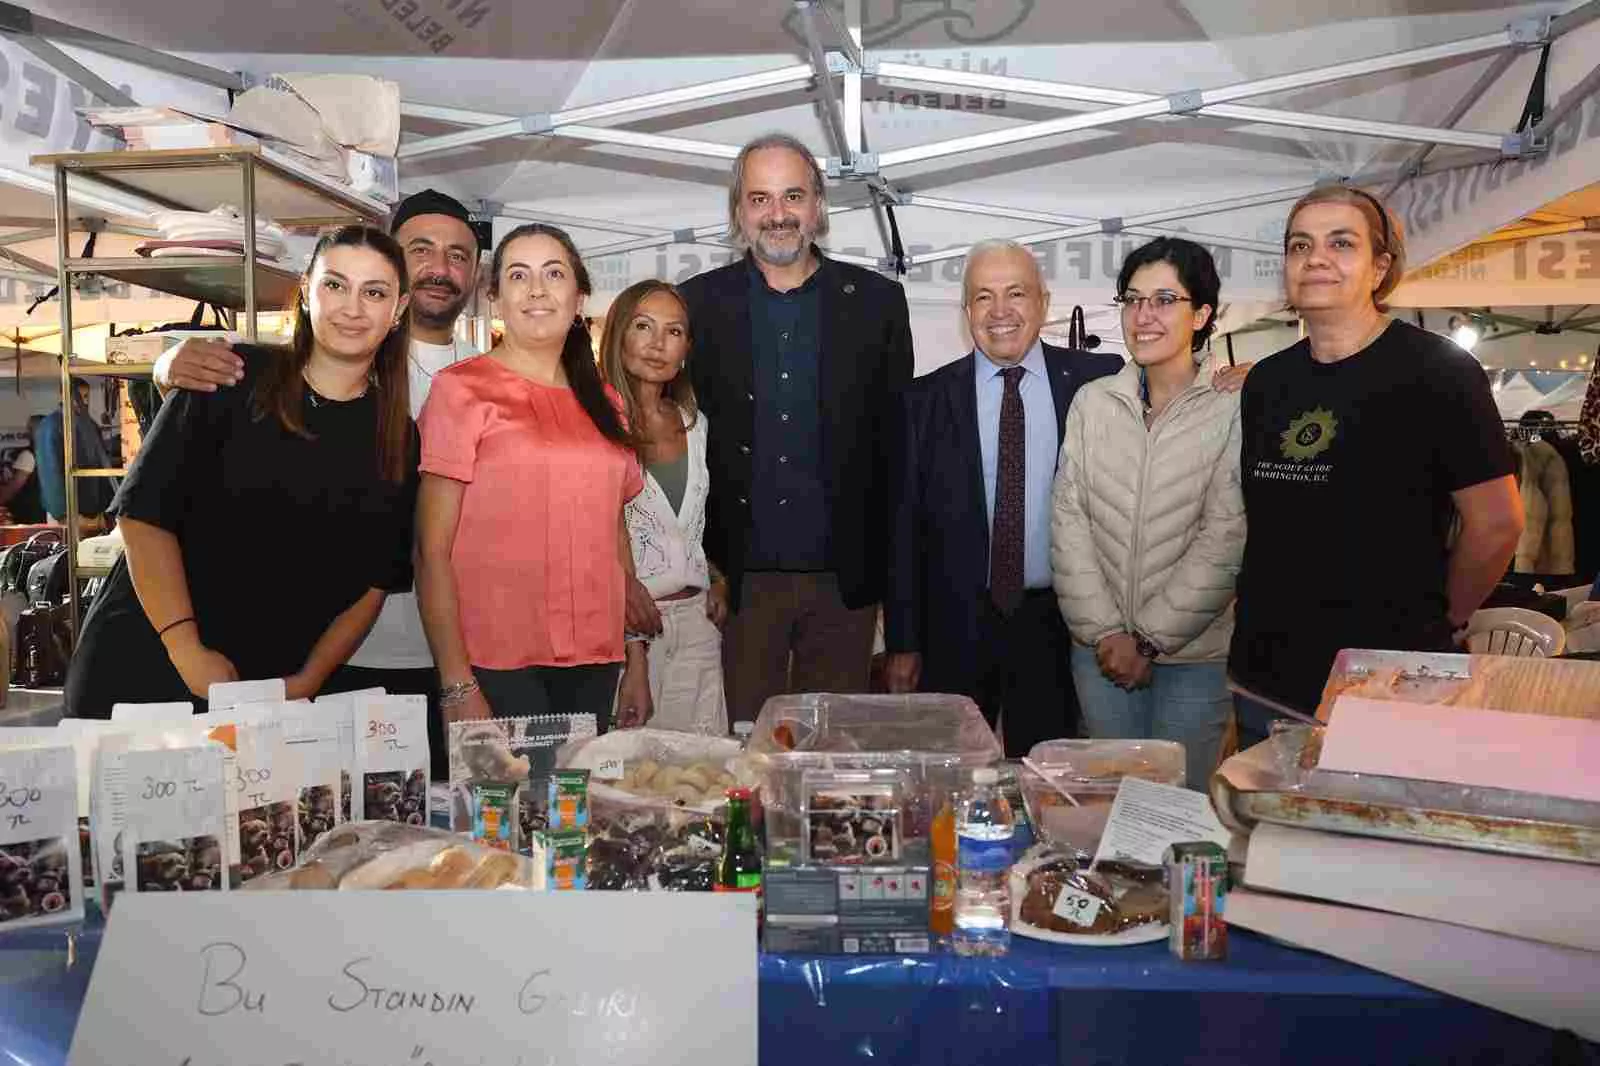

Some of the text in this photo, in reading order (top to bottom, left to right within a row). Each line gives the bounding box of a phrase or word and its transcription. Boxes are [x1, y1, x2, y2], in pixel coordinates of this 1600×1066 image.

[1273, 463, 1303, 472] SCOUT
[367, 719, 398, 737] 300
[141, 776, 177, 800] 300
[236, 766, 272, 793] 300
